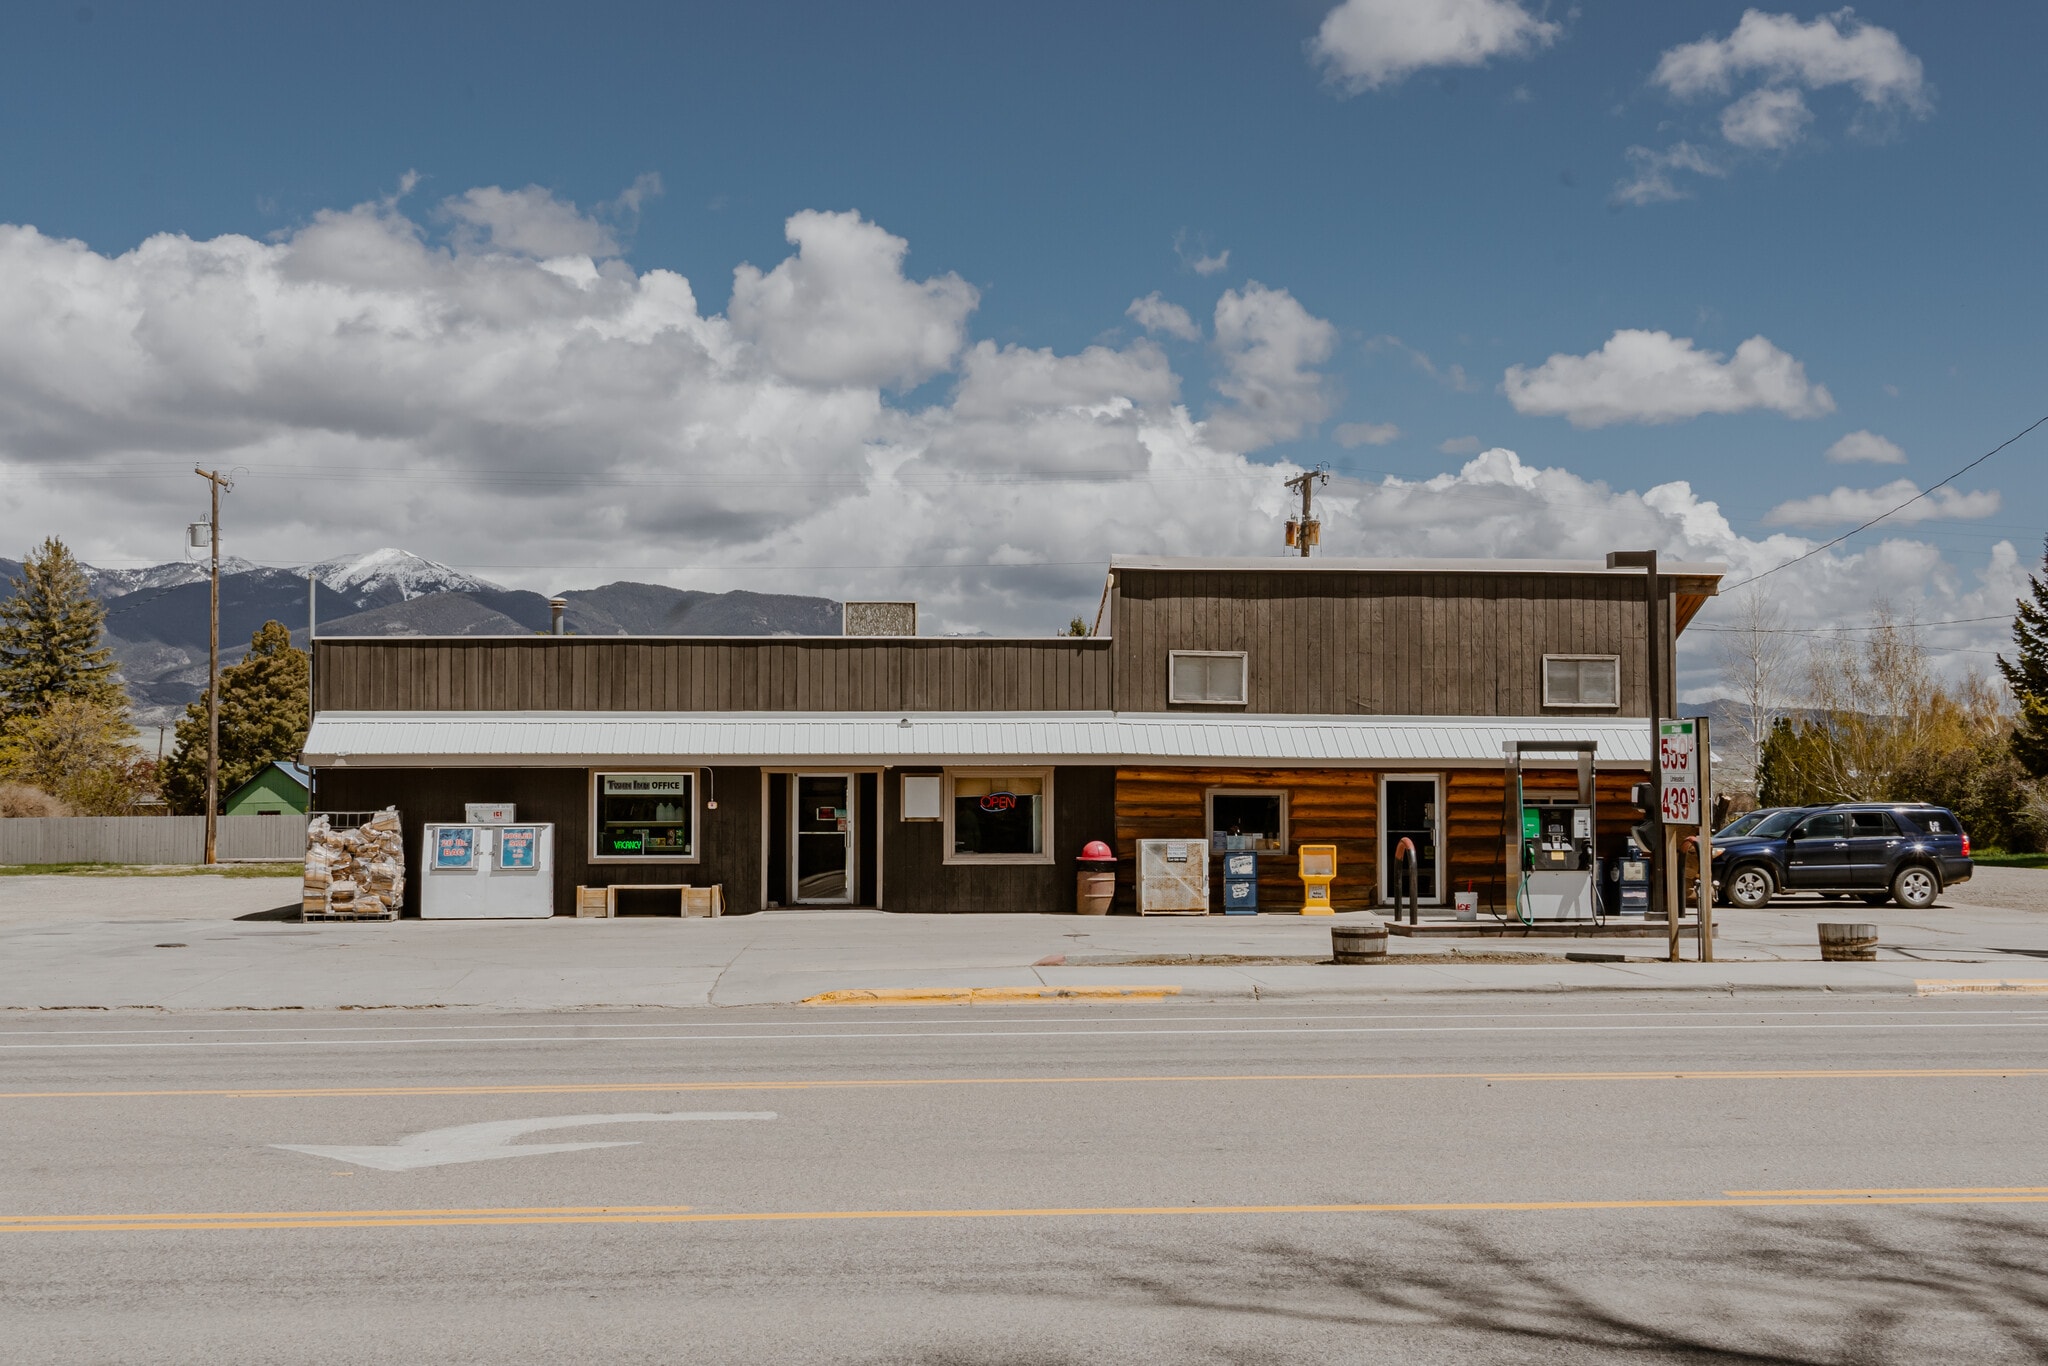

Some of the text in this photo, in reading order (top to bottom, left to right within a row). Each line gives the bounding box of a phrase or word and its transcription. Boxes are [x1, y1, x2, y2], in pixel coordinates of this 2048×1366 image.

[651, 781, 680, 790] OFFICE
[980, 795, 1016, 809] OPEN
[1662, 787, 1689, 819] 439
[613, 840, 642, 850] VACANCY
[443, 848, 465, 857] BAG
